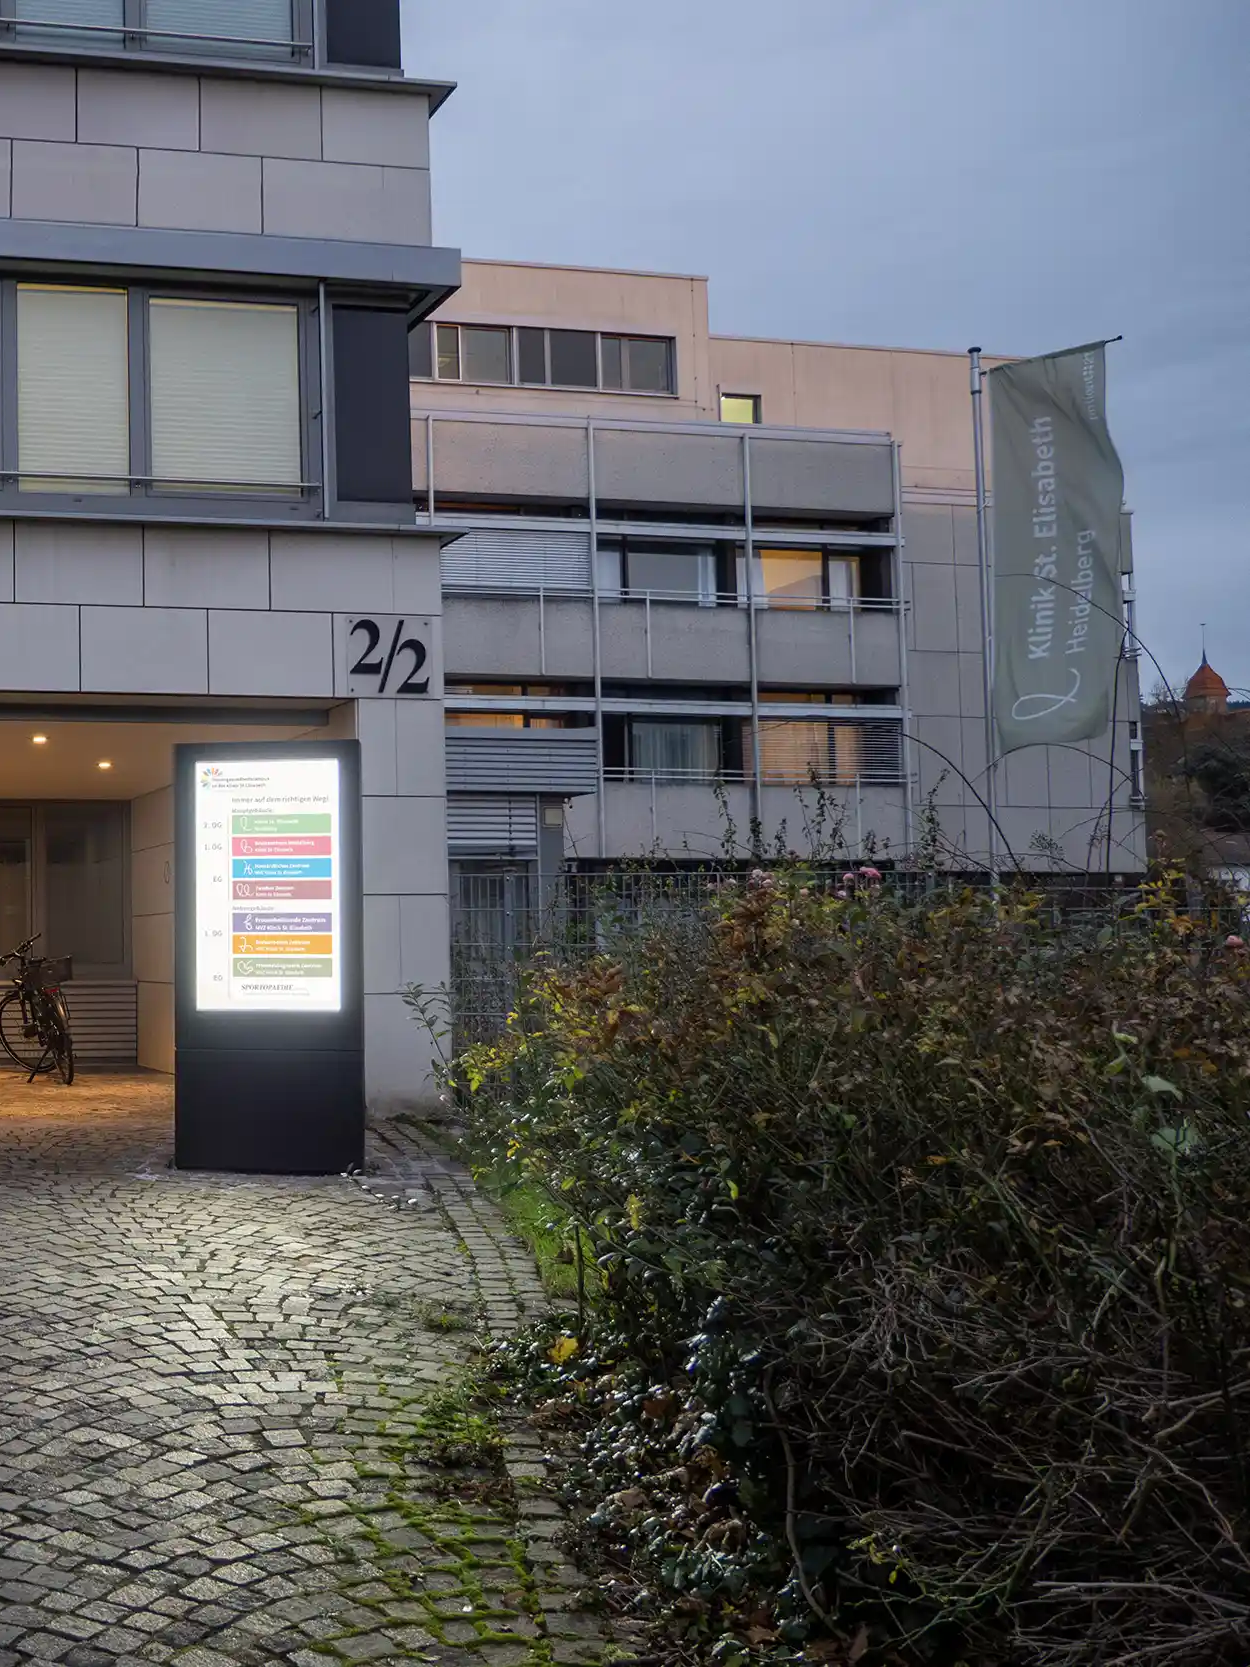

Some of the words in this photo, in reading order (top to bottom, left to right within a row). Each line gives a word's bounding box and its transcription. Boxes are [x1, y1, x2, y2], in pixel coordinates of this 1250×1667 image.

[1031, 416, 1057, 538] Elisabeth
[1033, 545, 1058, 582] St.
[1065, 530, 1095, 655] Heidelberg
[350, 619, 430, 694] 2/2
[1027, 585, 1055, 659] Klinik
[282, 796, 311, 804] richtigen
